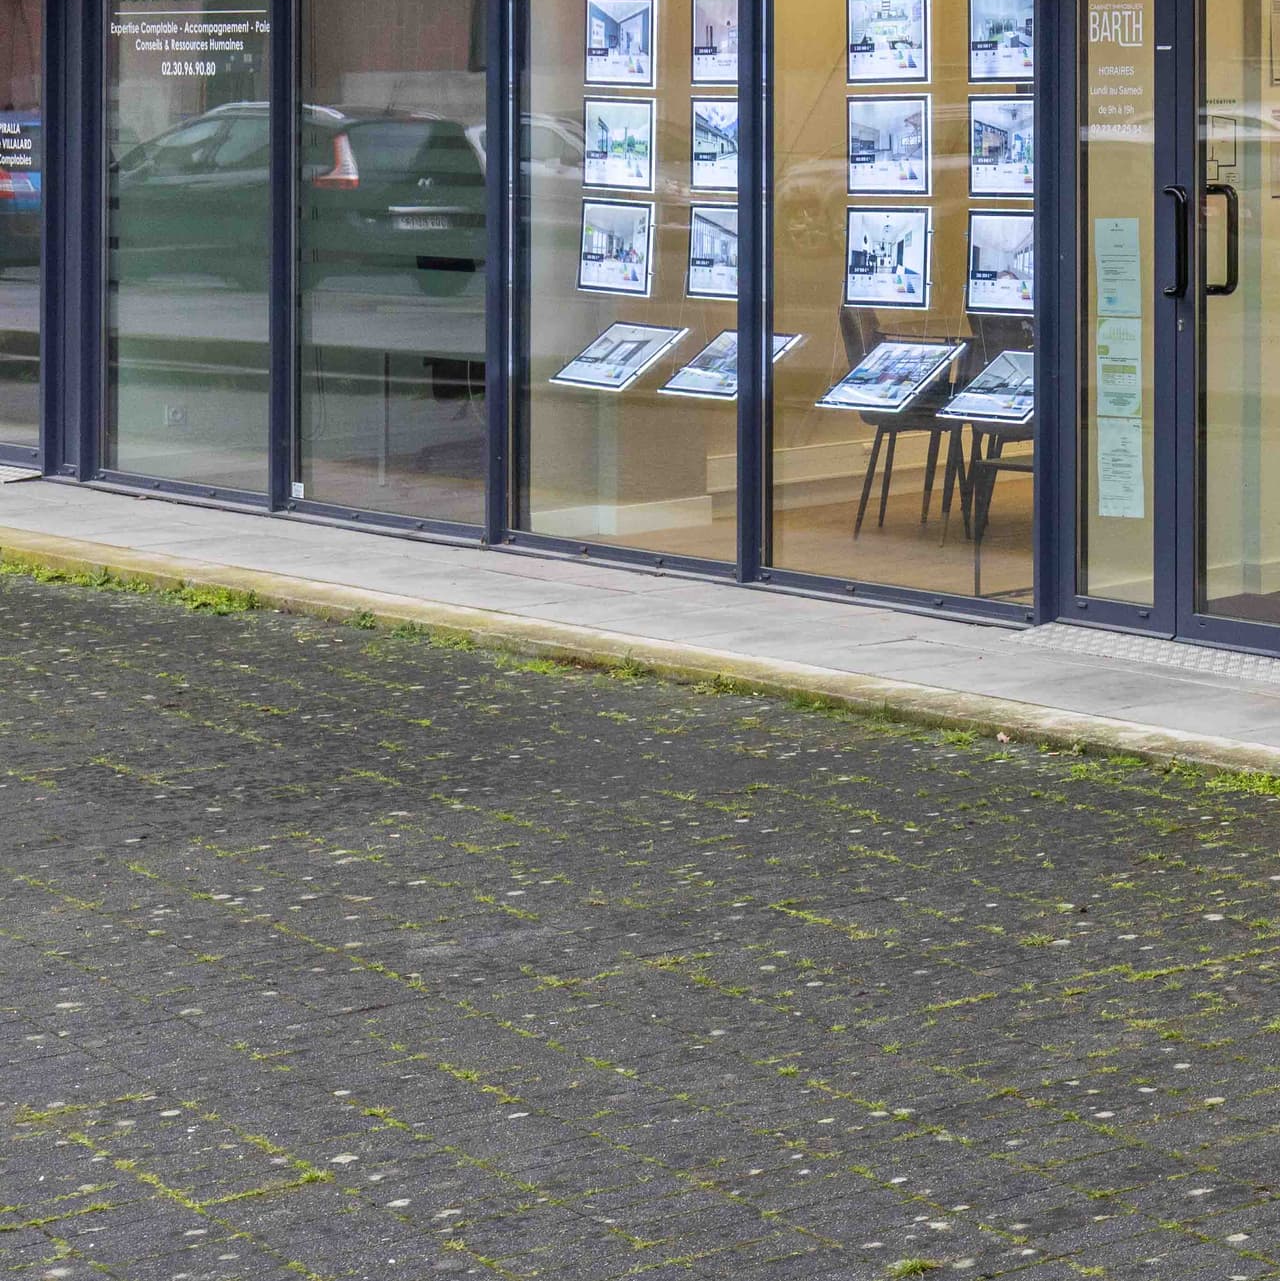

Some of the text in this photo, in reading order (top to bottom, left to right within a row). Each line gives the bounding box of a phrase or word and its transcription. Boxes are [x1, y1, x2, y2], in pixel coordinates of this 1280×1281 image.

[110, 21, 139, 36] Expertise
[140, 21, 178, 36] Comptable
[184, 21, 249, 36] Accompagnement
[1089, 10, 1143, 47] BARTH
[135, 39, 163, 51] Conseils
[171, 38, 208, 51] Ressources
[209, 38, 244, 51] Humaines
[161, 61, 216, 76] 02.30.96.90.80
